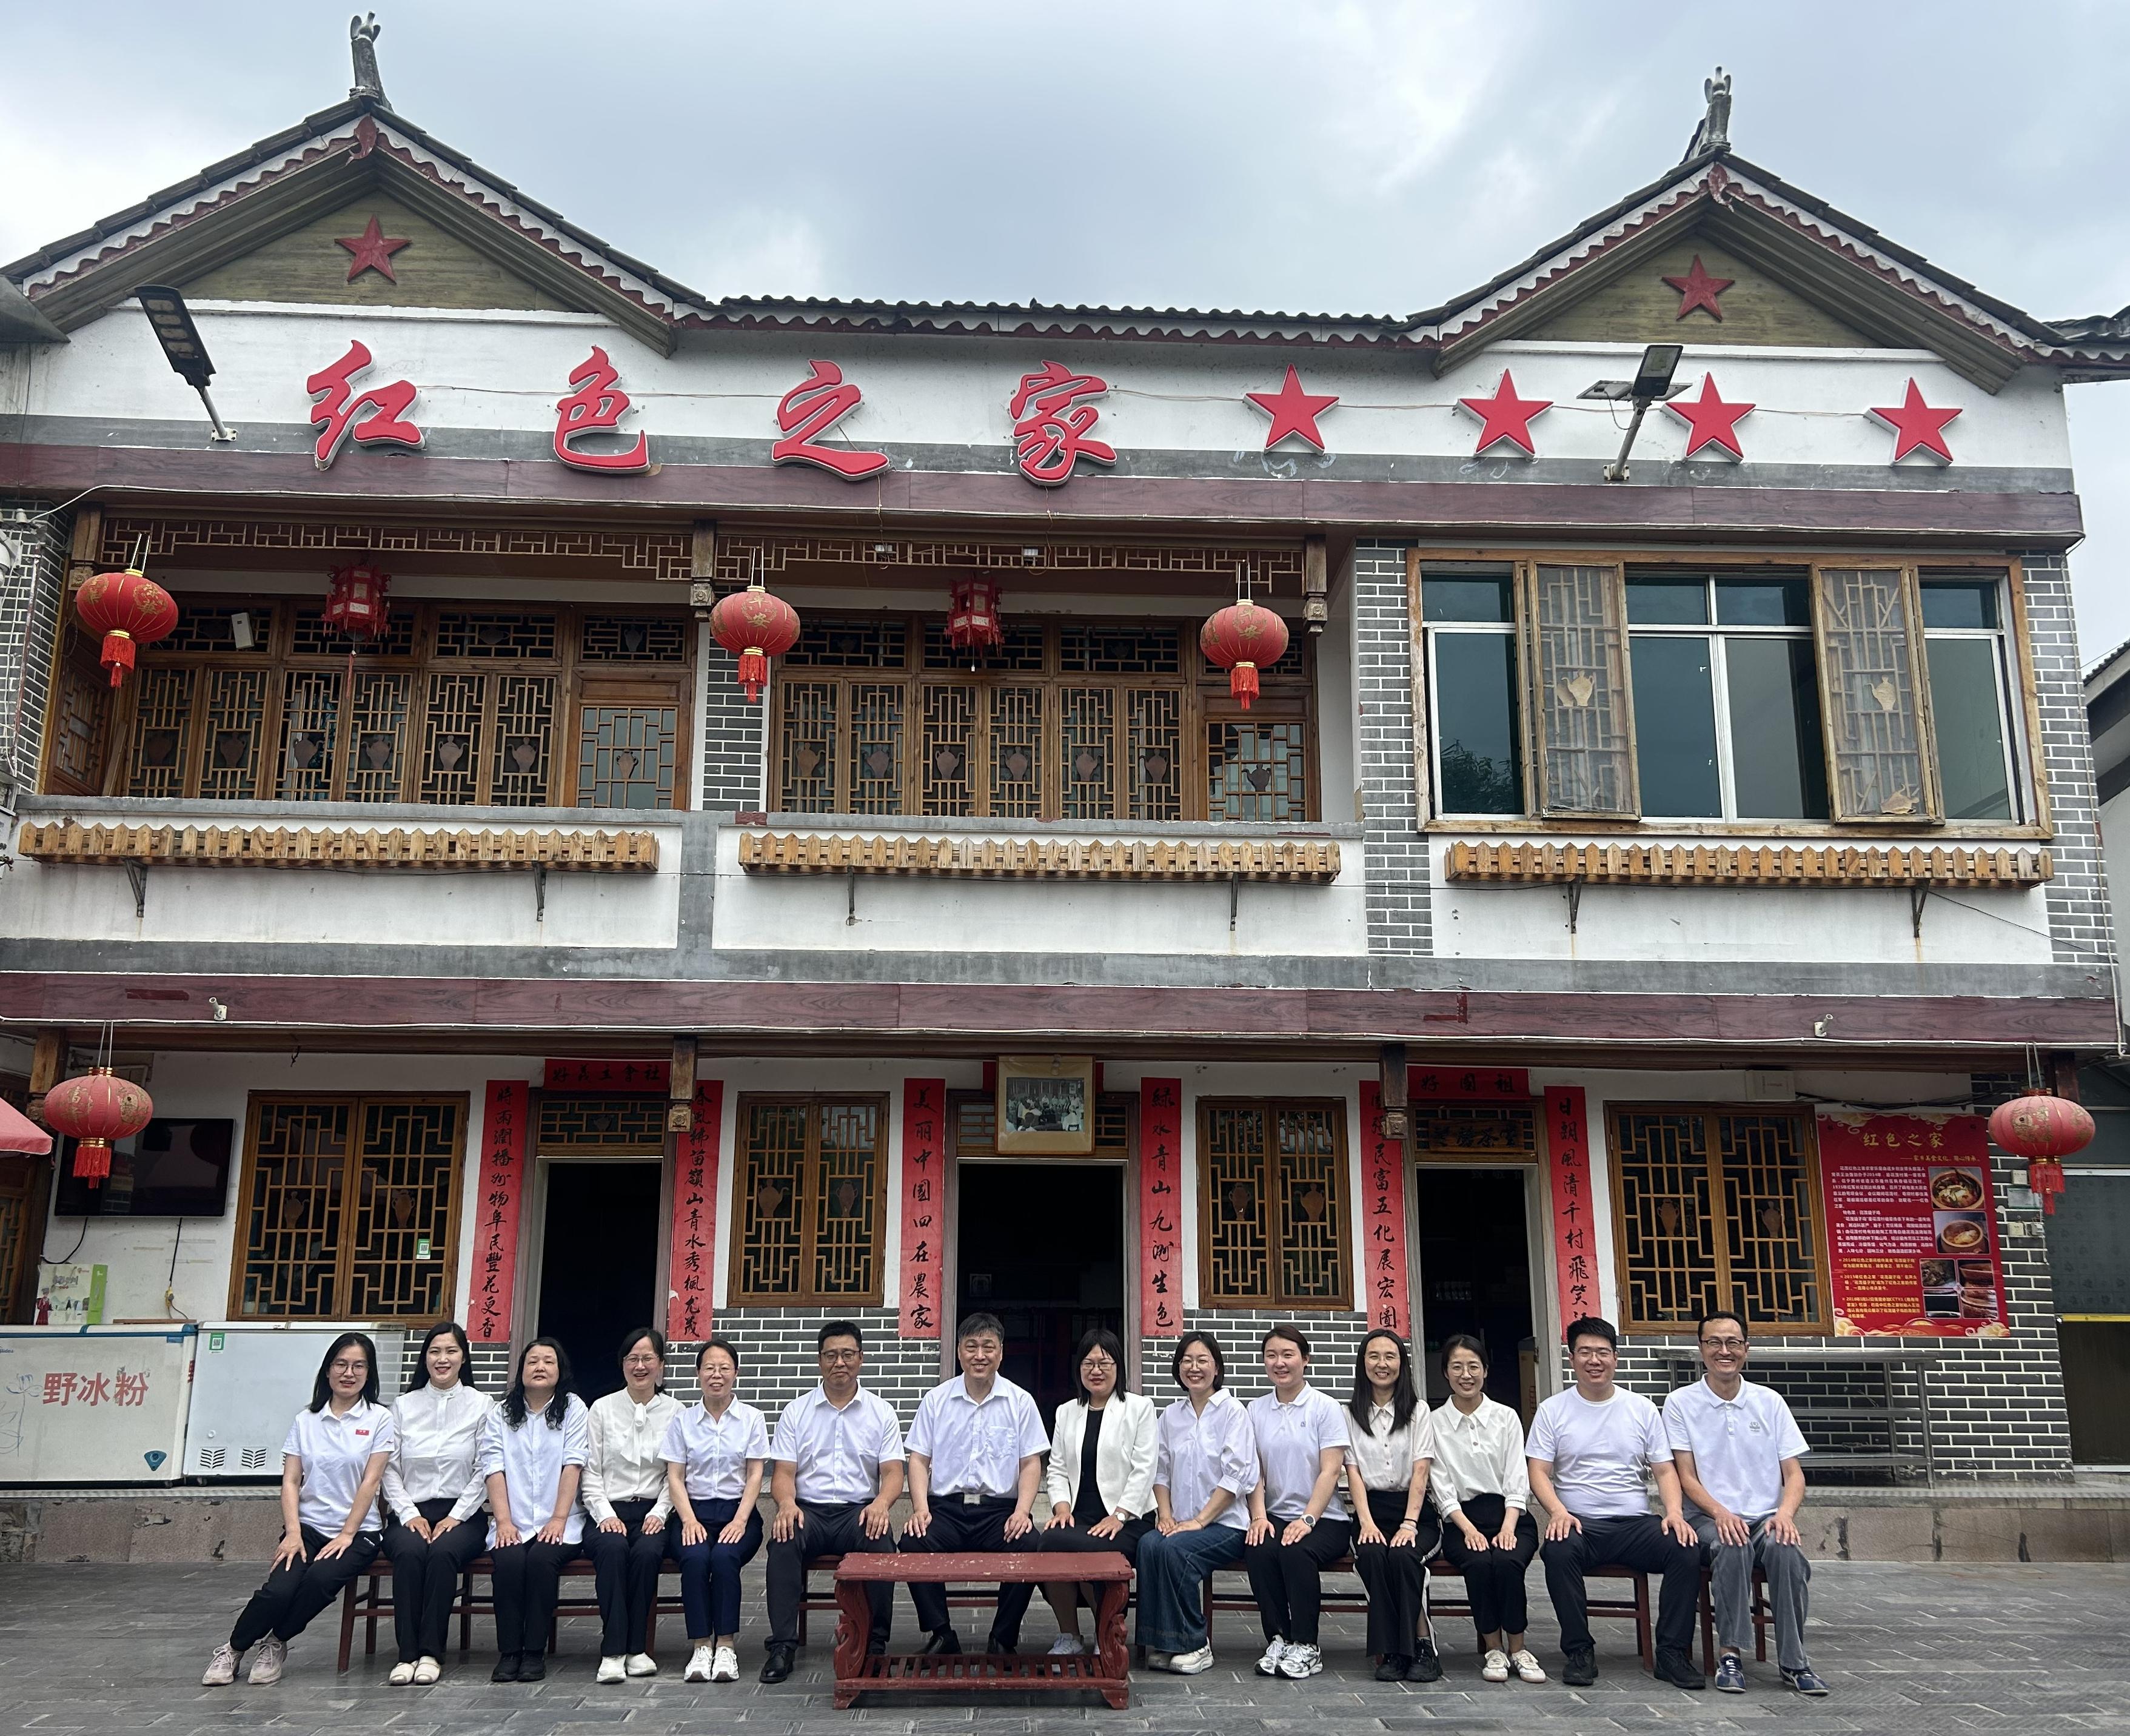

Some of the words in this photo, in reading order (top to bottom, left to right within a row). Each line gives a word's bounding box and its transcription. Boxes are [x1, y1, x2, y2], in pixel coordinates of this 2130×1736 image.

[306, 340, 1117, 486] 红色之家
[1863, 1132, 1944, 1148] 红色之家
[43, 1372, 149, 1407] 野冰粉
